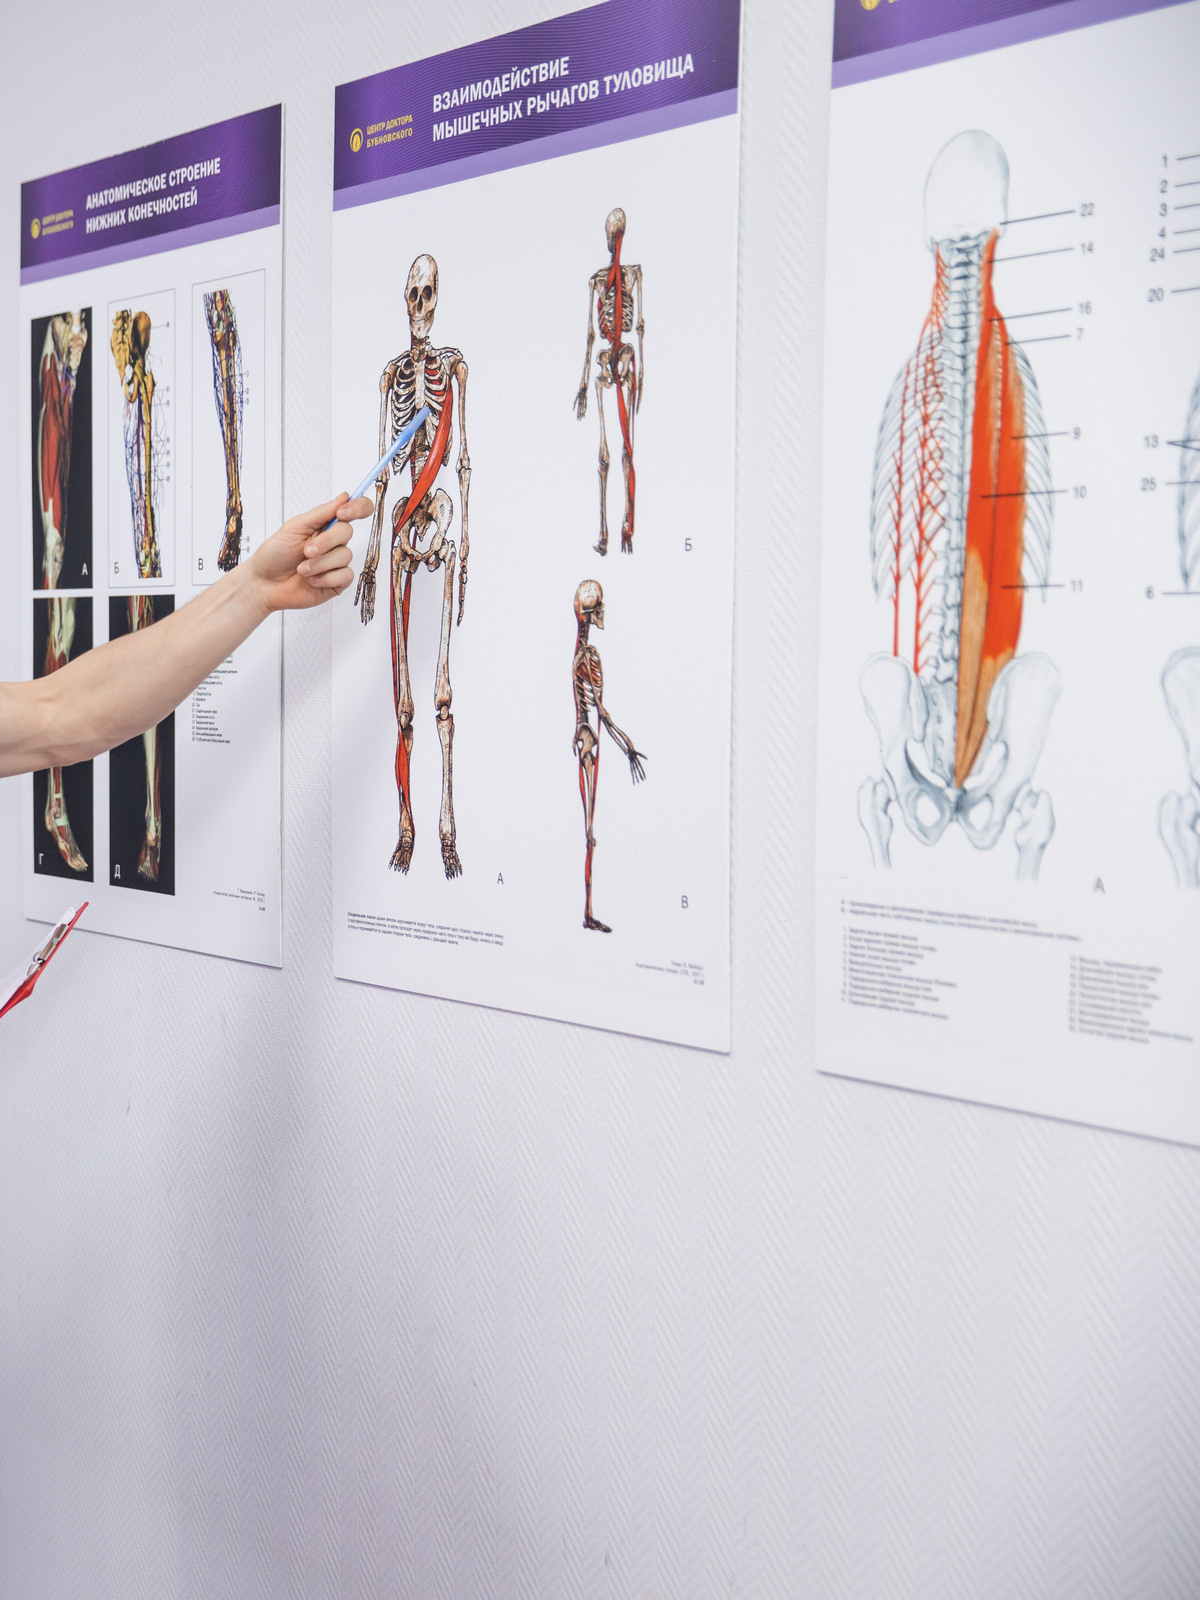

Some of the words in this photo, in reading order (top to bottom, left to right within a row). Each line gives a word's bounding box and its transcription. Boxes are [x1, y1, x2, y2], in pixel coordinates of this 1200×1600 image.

[433, 56, 570, 113] ВЗАИМОДЕЙСТВИЕ
[432, 99, 522, 142] МЫШЕЧНЫХ
[527, 80, 599, 117] РЫЧАГОВ
[603, 53, 695, 95] ТУЛОВИЩА
[366, 121, 385, 135] ЦЕНТР
[385, 114, 413, 131] ДОКТОРА
[366, 127, 413, 148] БУБНОВСКОГО
[1162, 154, 1168, 168] 1
[86, 173, 167, 211] АНАТОМИЧЕСКОЕ
[169, 157, 221, 187] СТРОЕНИЕ
[1160, 180, 1168, 194] 2
[85, 208, 126, 234] НИЖНИХ
[128, 186, 198, 223] КОНЕЧНОСТЕЙ
[1080, 202, 1095, 217] 22
[1159, 203, 1168, 217] 3
[1158, 227, 1166, 239] 4
[1081, 242, 1094, 255] 14
[1149, 248, 1165, 262] 24
[1148, 288, 1164, 302] 20
[1079, 301, 1093, 315] 16
[1076, 328, 1084, 341] 7
[1073, 427, 1081, 440] 9
[1144, 435, 1159, 449] 13
[1073, 485, 1087, 498] 10
[1141, 478, 1157, 491] 25
[685, 538, 692, 551] Б
[82, 563, 89, 575] А
[114, 561, 120, 574] Б
[198, 558, 204, 571] В
[1071, 580, 1084, 592] 11
[1146, 586, 1154, 600] 6
[38, 852, 44, 867] Г
[114, 864, 121, 880] Д
[497, 872, 504, 885] А
[1093, 877, 1106, 894] А
[681, 895, 689, 909] В
